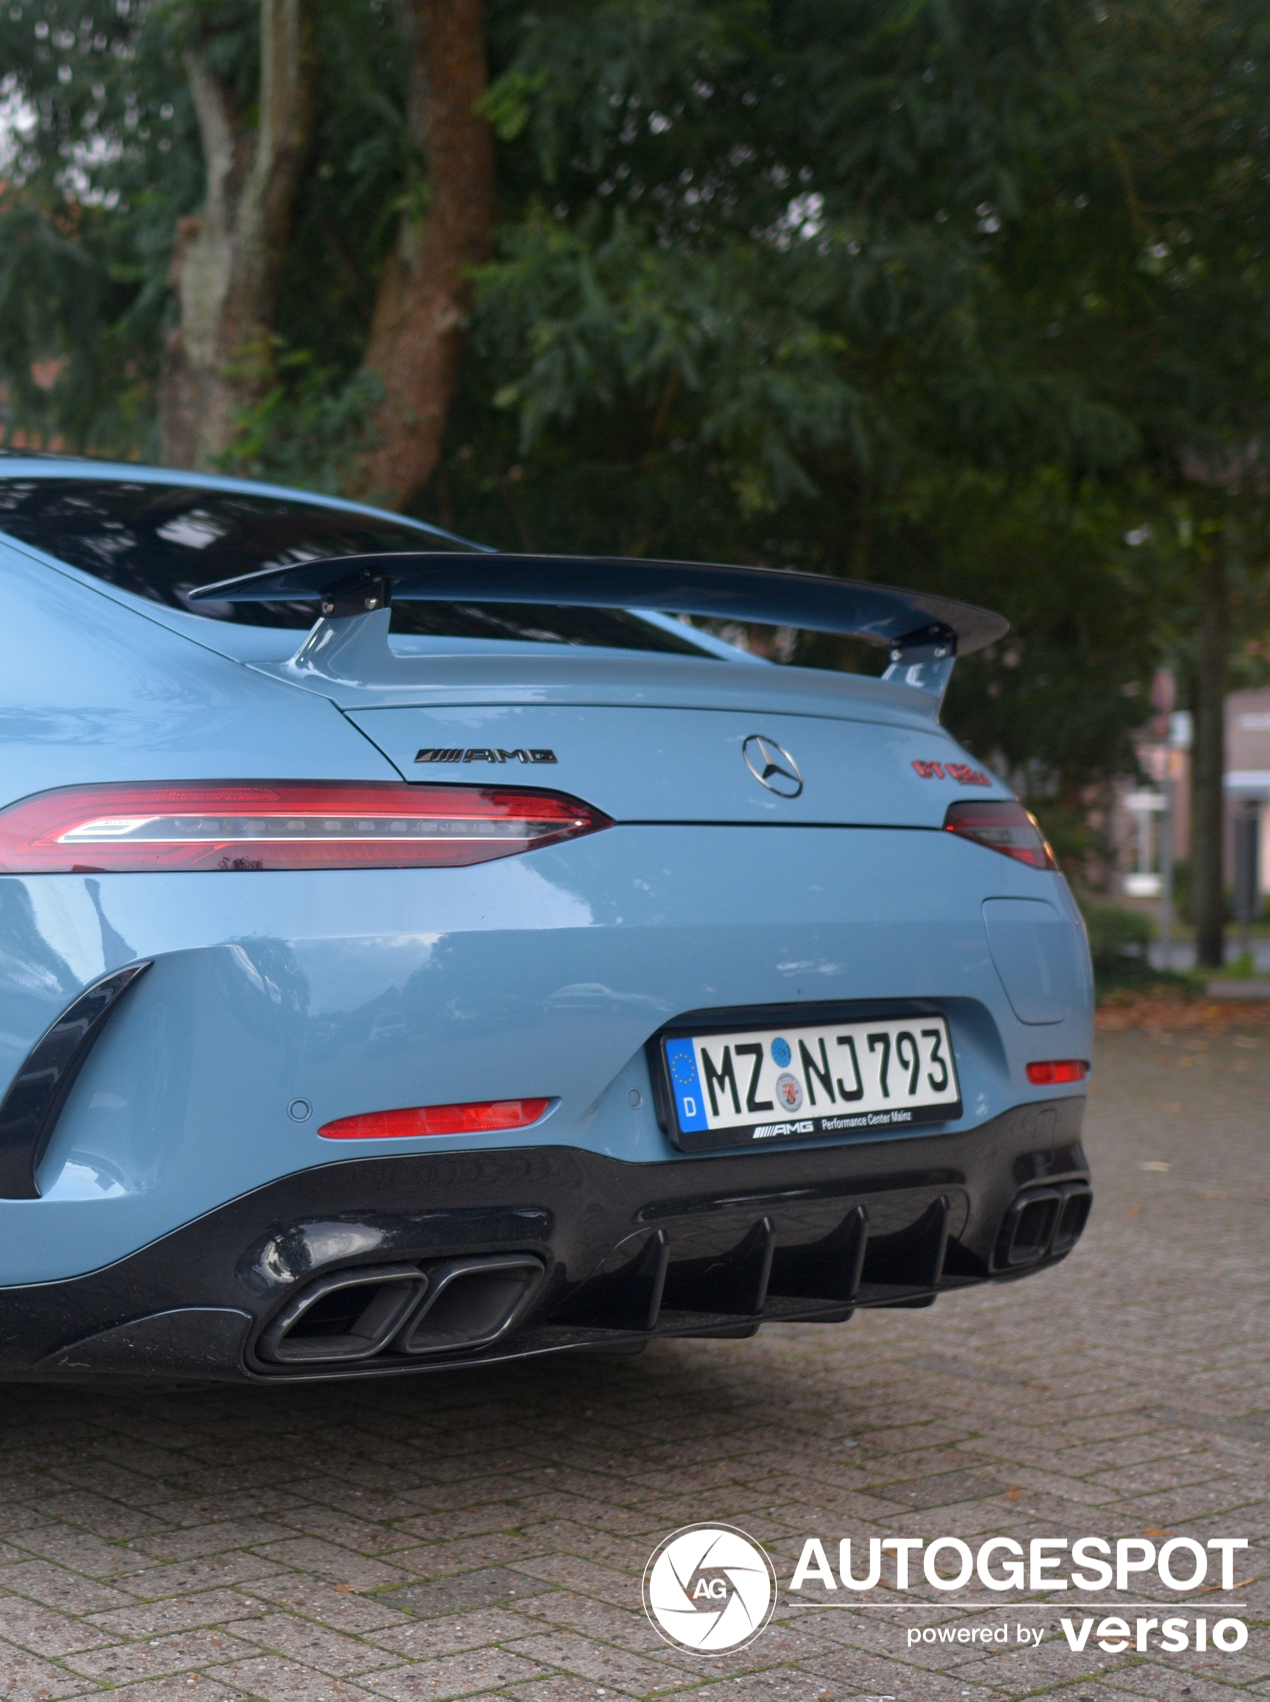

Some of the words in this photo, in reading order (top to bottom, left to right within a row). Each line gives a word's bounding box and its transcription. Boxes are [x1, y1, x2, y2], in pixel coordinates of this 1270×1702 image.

[463, 749, 558, 763] AMG
[700, 1042, 774, 1117] MZ
[684, 1097, 697, 1117] D
[773, 1120, 814, 1136] AMG
[822, 1115, 867, 1130] Performance
[868, 1112, 890, 1125] Center
[891, 1110, 913, 1121] Mainz
